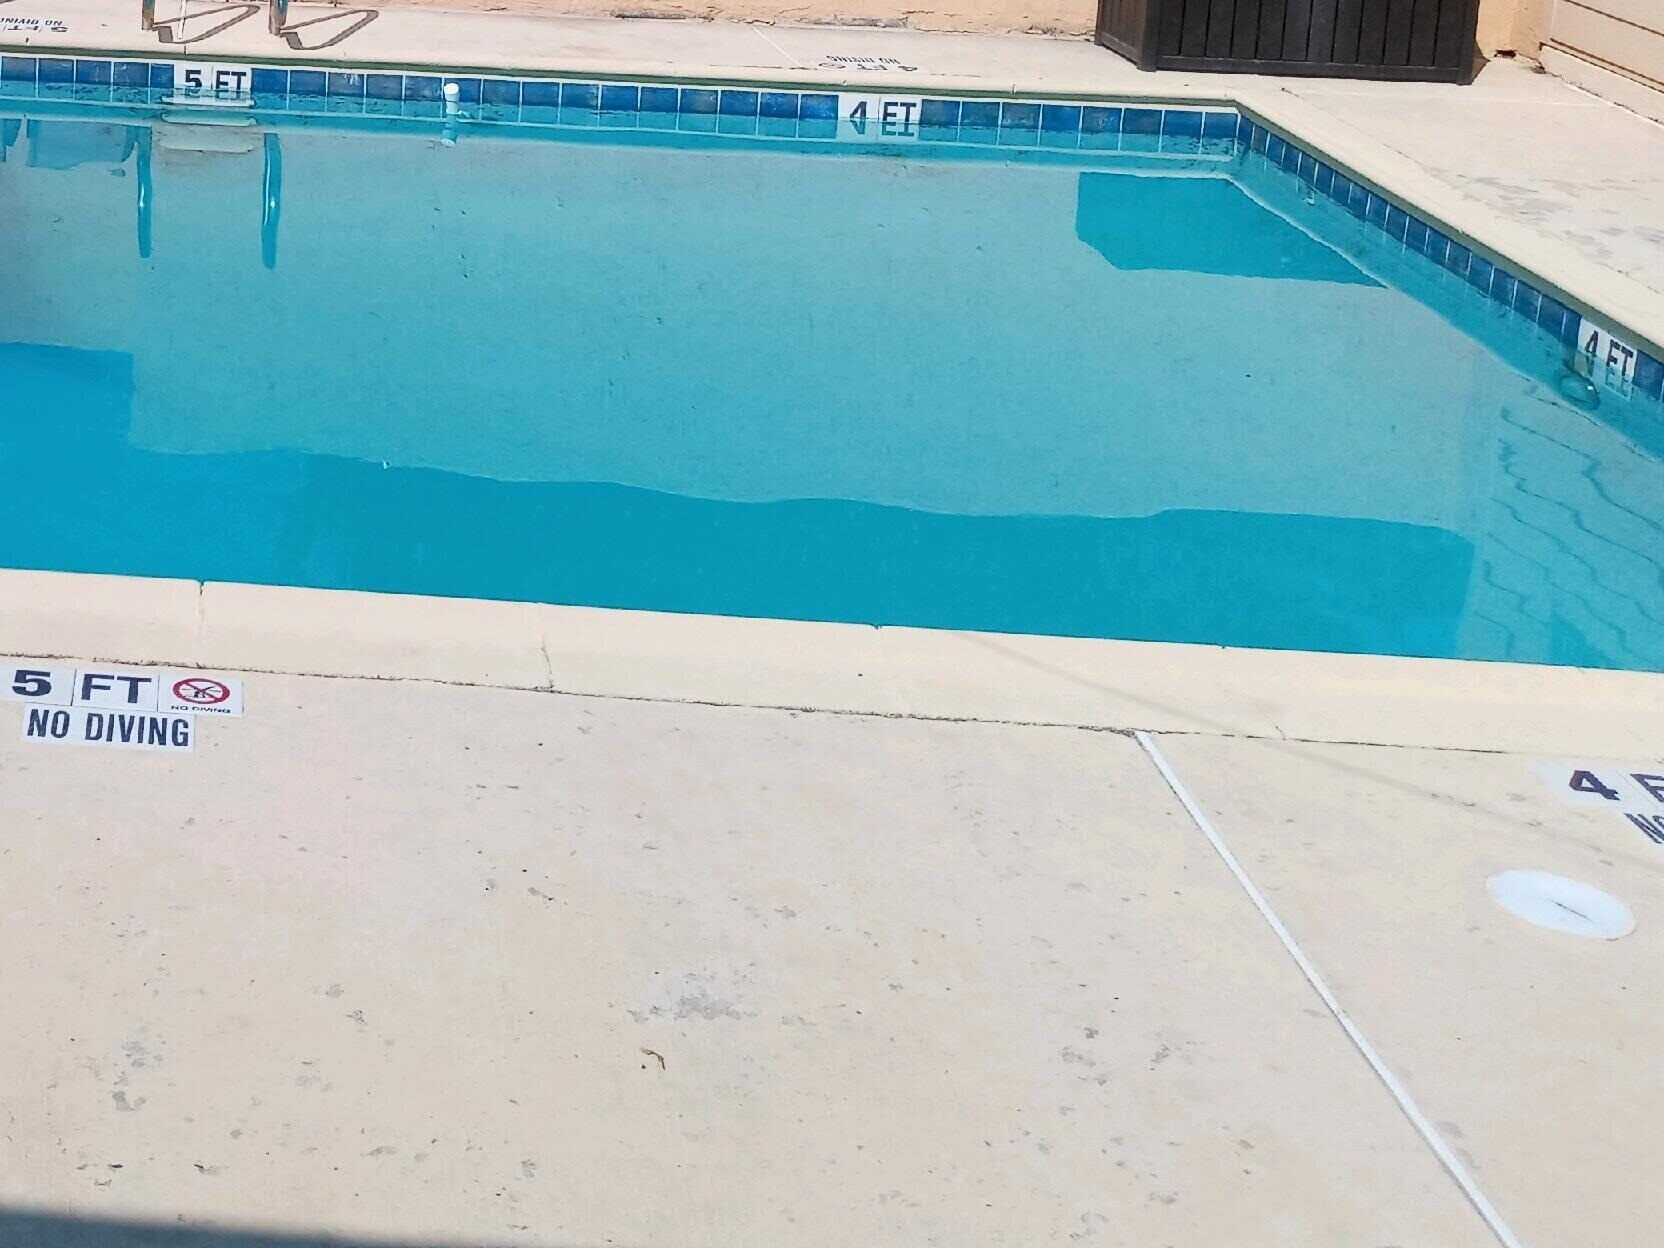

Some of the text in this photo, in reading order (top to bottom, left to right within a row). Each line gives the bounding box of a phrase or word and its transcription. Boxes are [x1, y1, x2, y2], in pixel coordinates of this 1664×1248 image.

[185, 69, 247, 90] 5 FT
[1584, 330, 1634, 377] 4 FT
[11, 669, 153, 704] 5 FT
[26, 708, 189, 747] NO DIVING
[1568, 769, 1621, 801] 4
